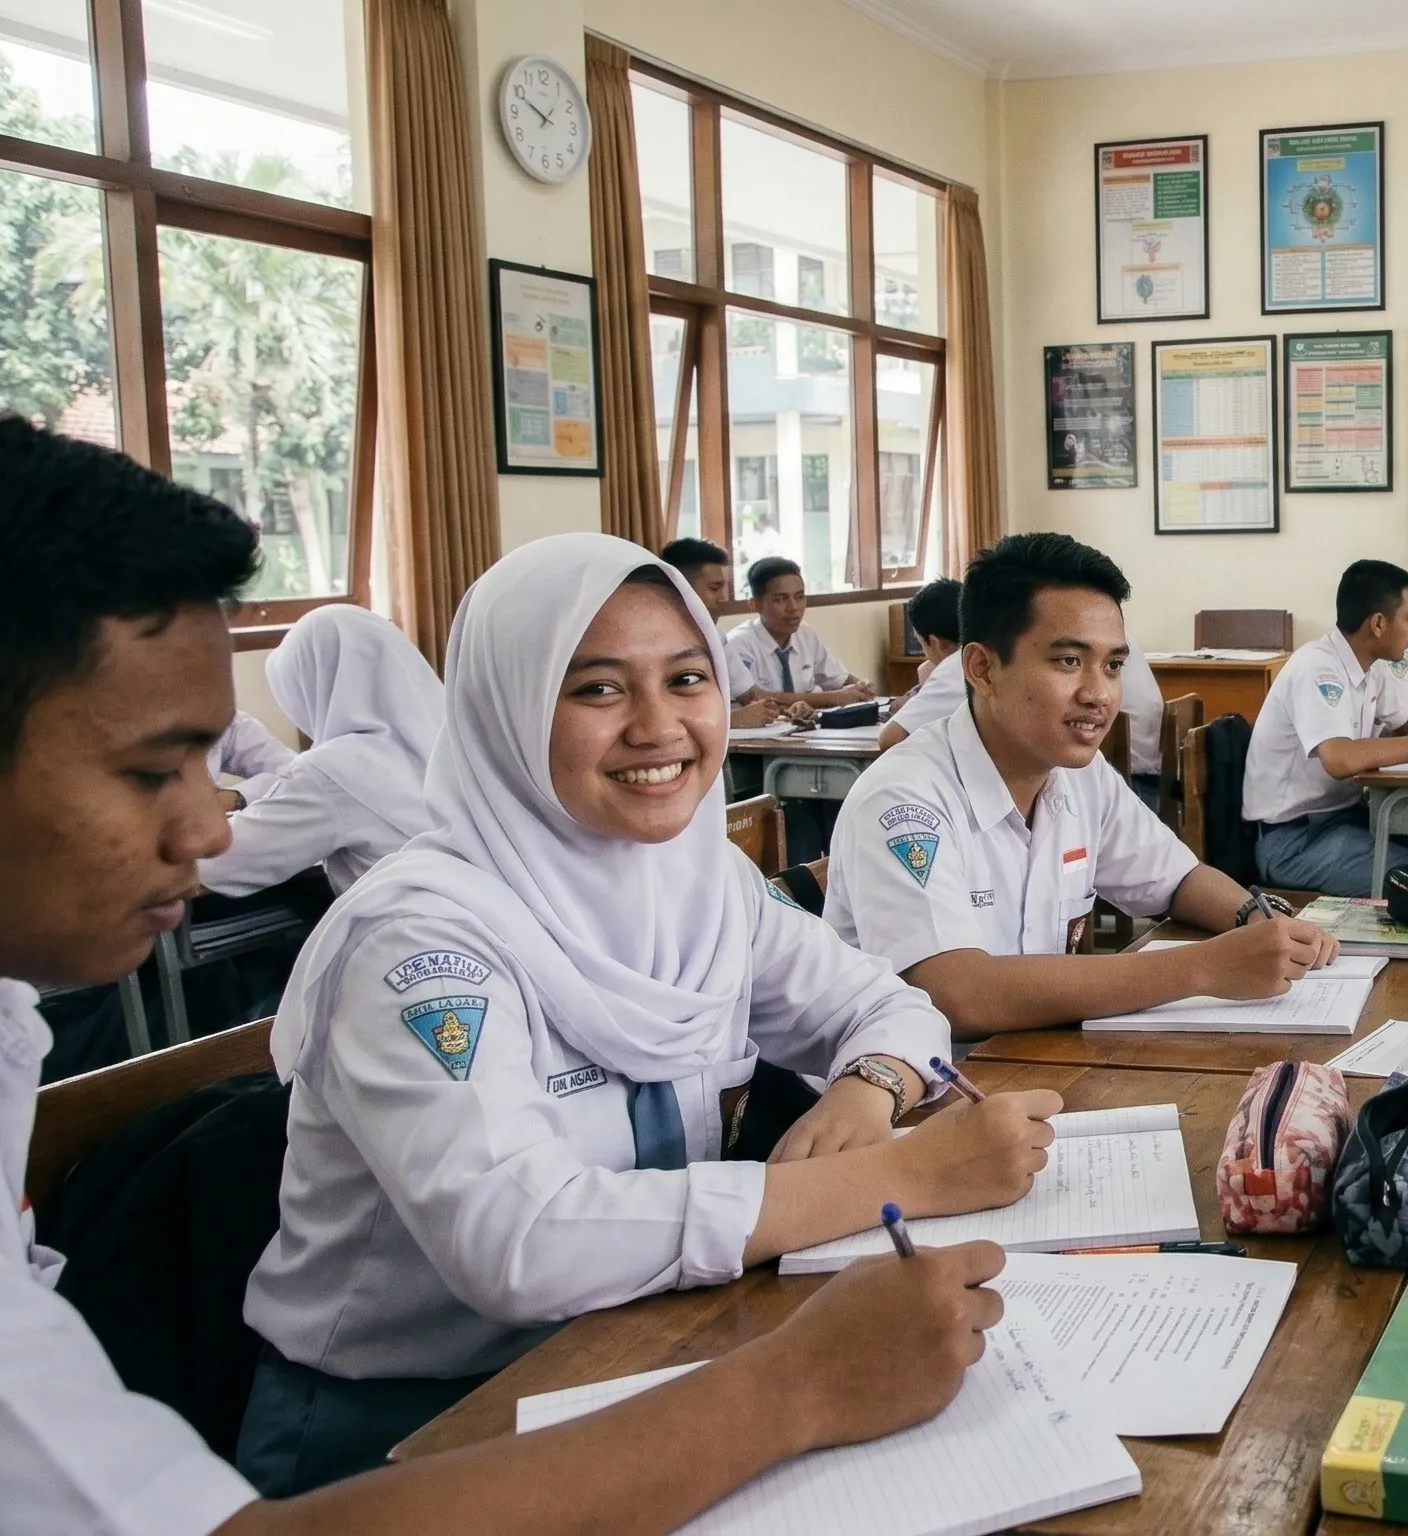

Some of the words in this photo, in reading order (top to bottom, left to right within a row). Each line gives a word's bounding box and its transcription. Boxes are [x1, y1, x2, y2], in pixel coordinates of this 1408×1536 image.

[524, 69, 534, 88] 11
[538, 69, 549, 87] 12
[510, 103, 519, 120] 9
[565, 99, 574, 115] 2
[516, 126, 524, 142] 8
[569, 121, 578, 137] 3
[527, 144, 535, 160] 7
[566, 142, 575, 156] 4
[541, 153, 550, 170] 6
[556, 152, 564, 168] 5
